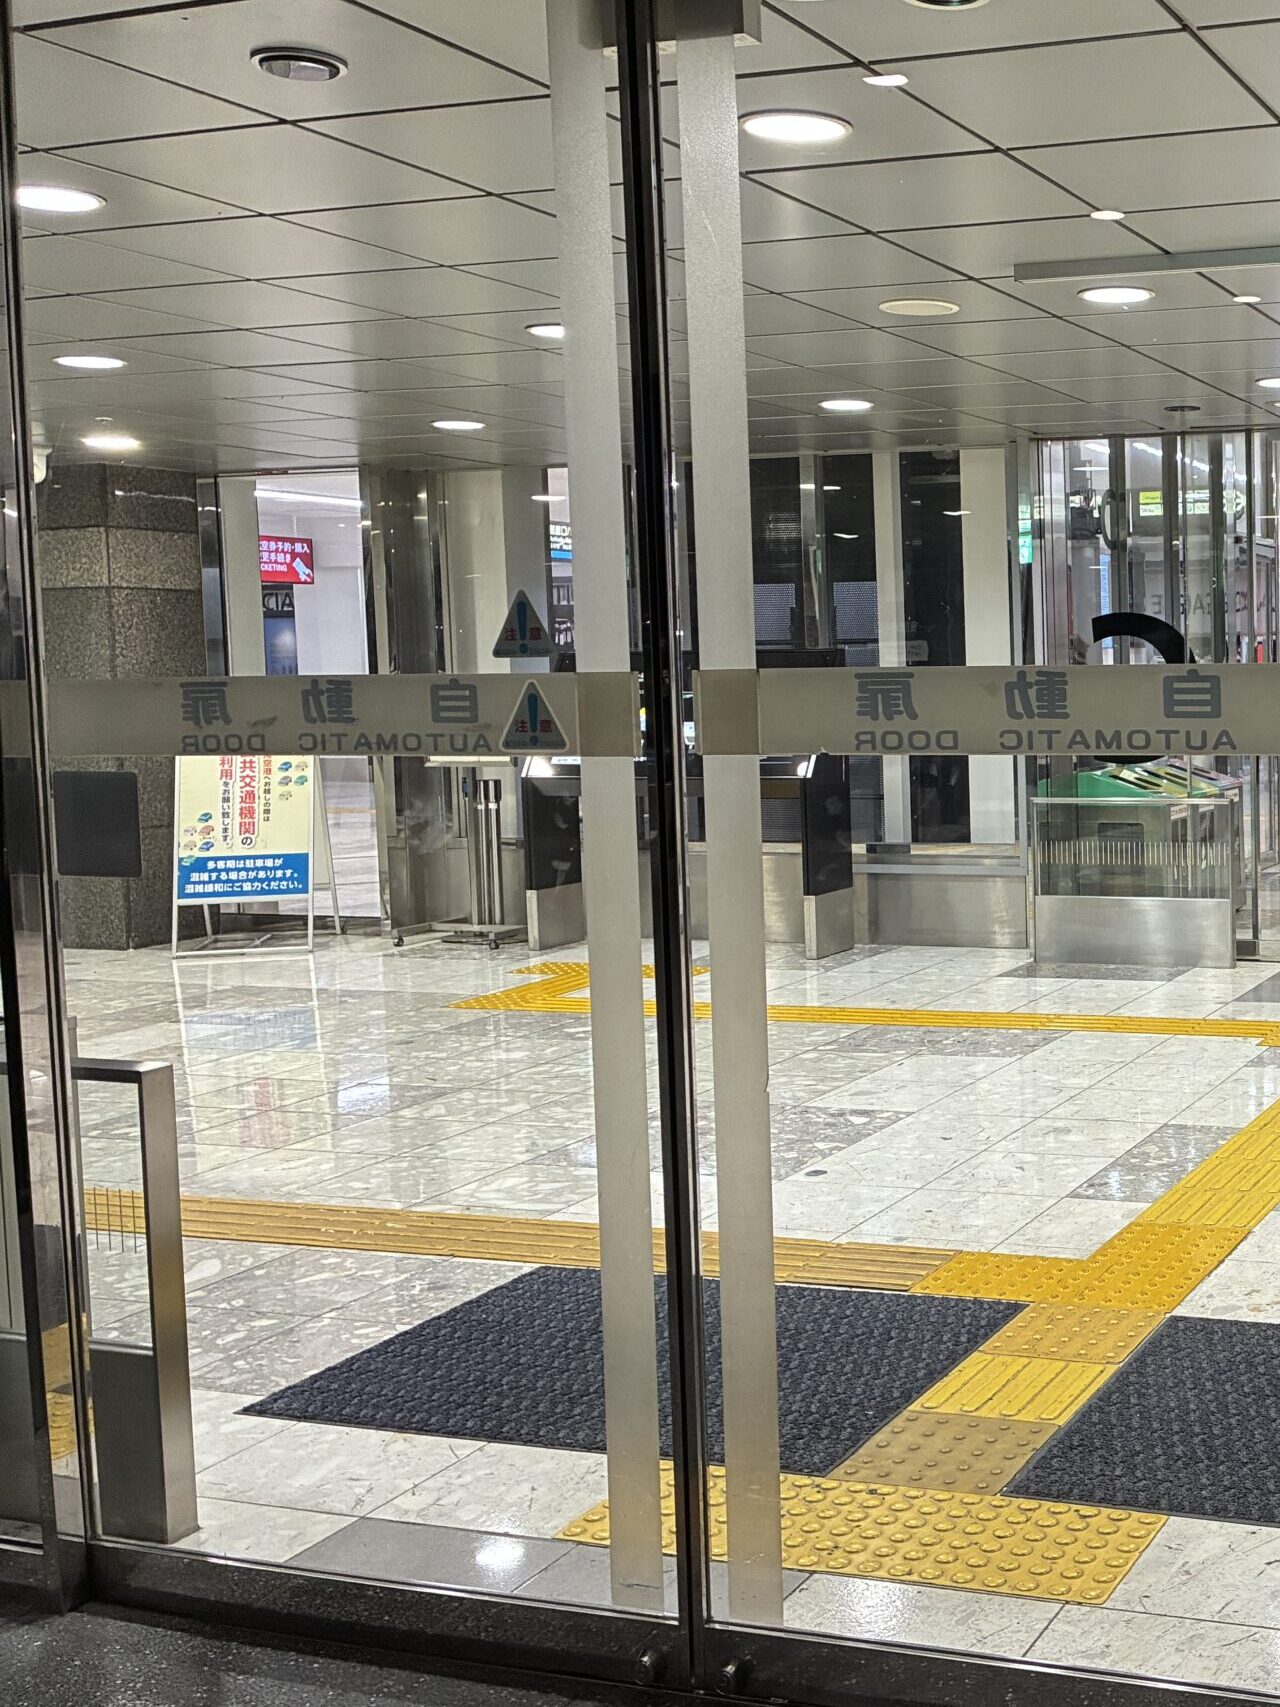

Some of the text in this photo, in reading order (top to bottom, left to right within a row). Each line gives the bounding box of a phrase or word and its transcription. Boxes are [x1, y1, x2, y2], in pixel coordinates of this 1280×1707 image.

[259, 541, 310, 553] 空券予約・購入
[239, 756, 256, 846] 共交通機関の
